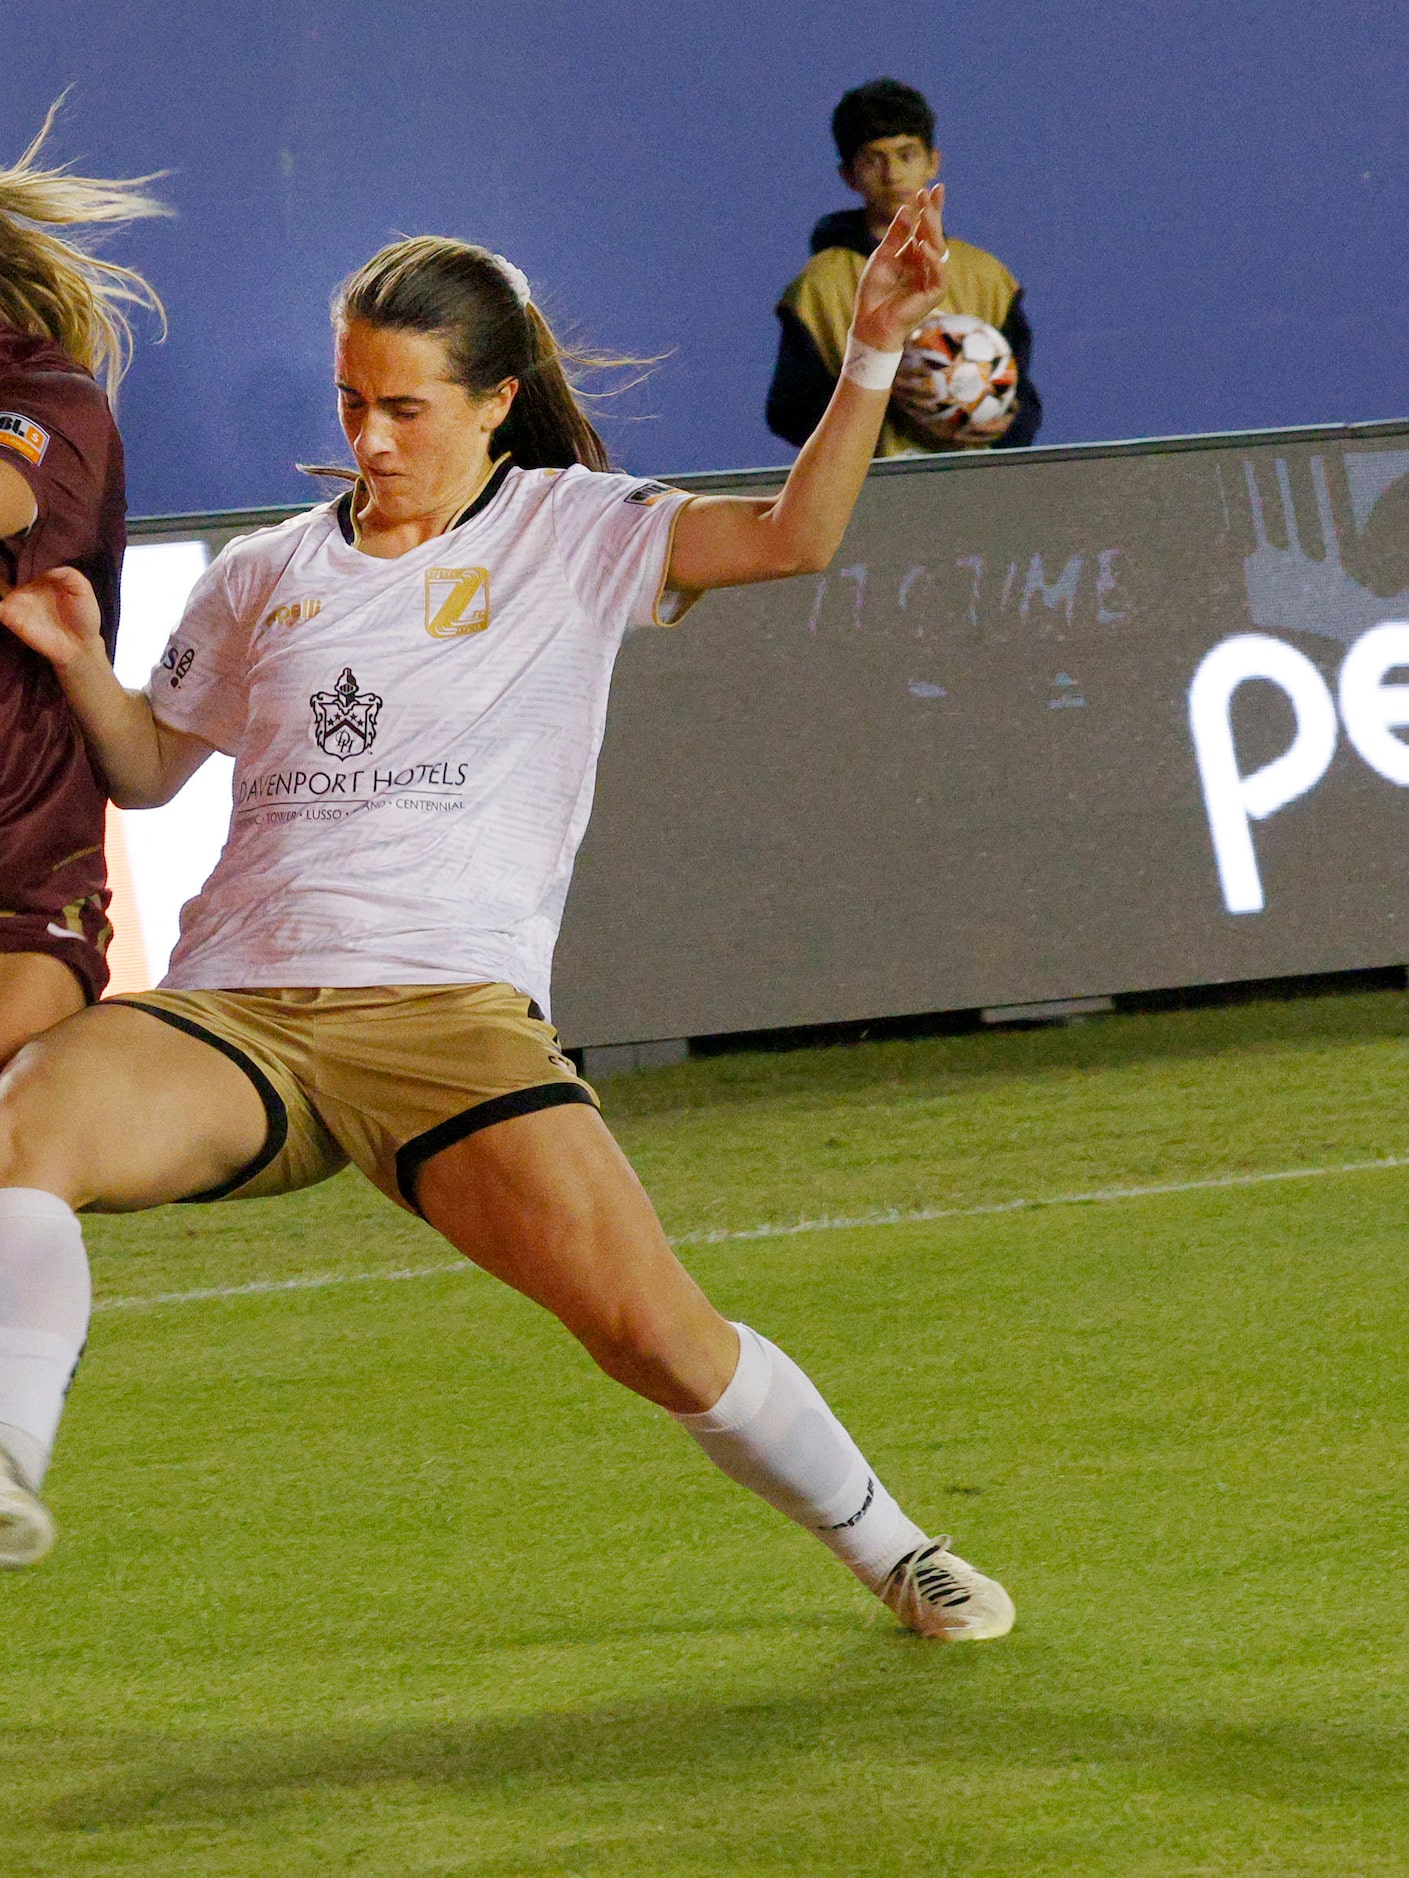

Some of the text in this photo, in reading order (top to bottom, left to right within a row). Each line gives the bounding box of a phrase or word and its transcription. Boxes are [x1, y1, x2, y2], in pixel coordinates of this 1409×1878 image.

[238, 763, 469, 803] DAVENPORT HOTELS
[306, 809, 342, 821] LUSSO
[395, 798, 465, 812] CENTENNIAL
